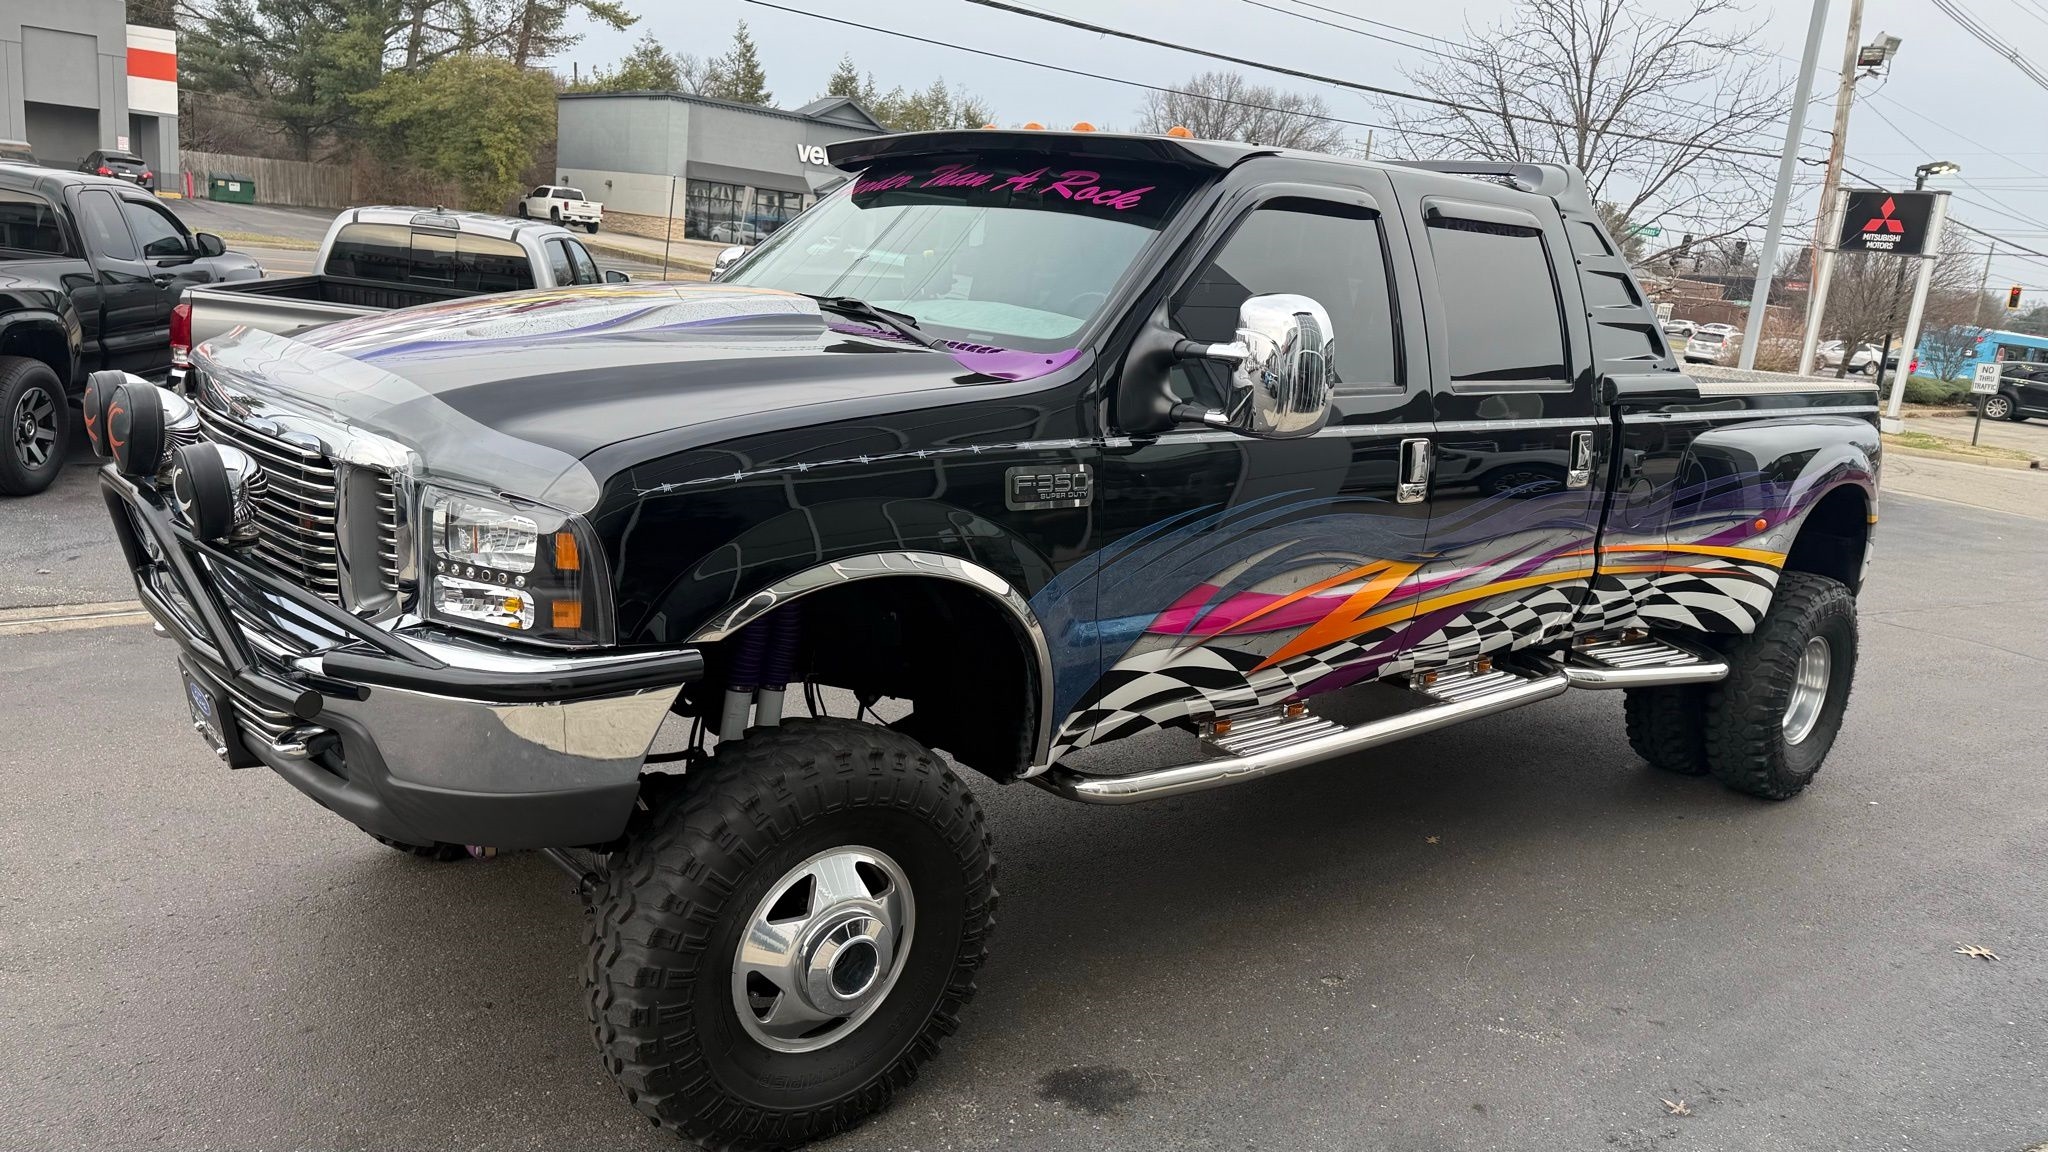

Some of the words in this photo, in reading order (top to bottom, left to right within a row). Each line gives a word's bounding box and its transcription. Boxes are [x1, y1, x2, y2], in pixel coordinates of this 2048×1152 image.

[919, 163, 994, 189] Than
[989, 166, 1050, 192] A
[1038, 170, 1156, 210] Rock
[1862, 232, 1902, 242] MITSUBISHI
[1866, 241, 1894, 250] MOTORS
[1982, 366, 1995, 374] NO
[1974, 383, 1996, 391] TRAFFIC
[1040, 492, 1066, 500] SUPER
